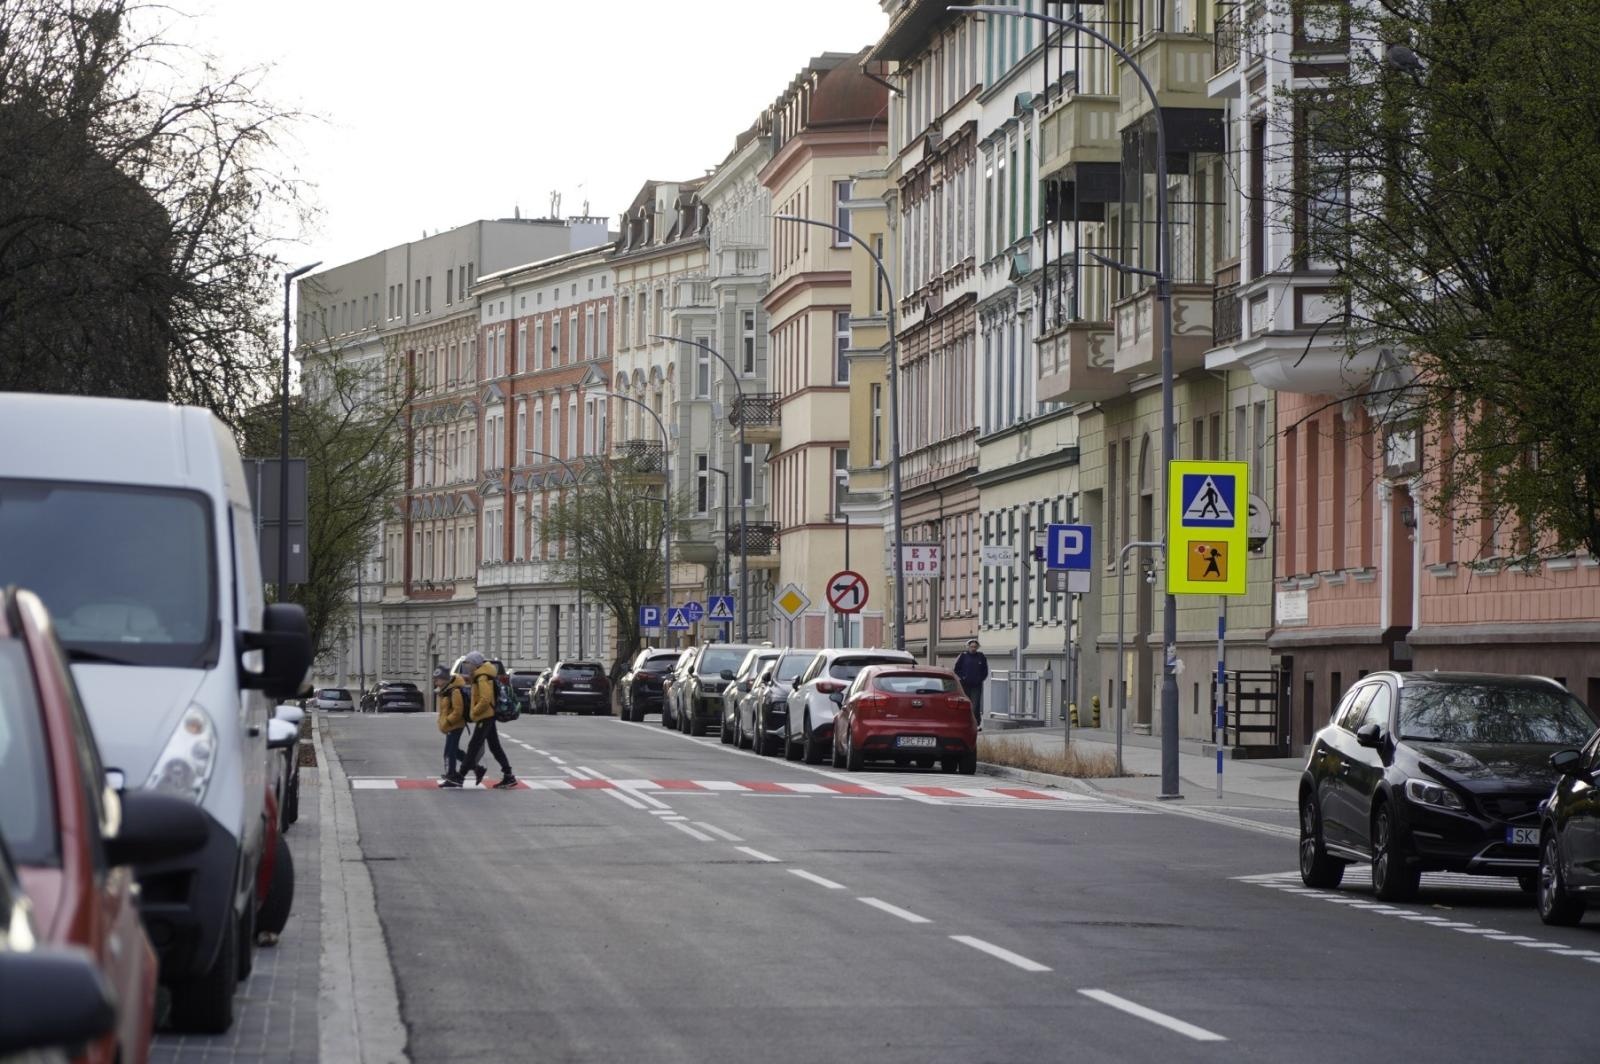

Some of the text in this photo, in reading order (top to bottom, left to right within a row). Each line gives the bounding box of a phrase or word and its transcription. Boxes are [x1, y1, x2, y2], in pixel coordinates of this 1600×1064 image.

[1057, 529, 1084, 565] P
[644, 608, 657, 625] P
[1515, 829, 1534, 844] SK
